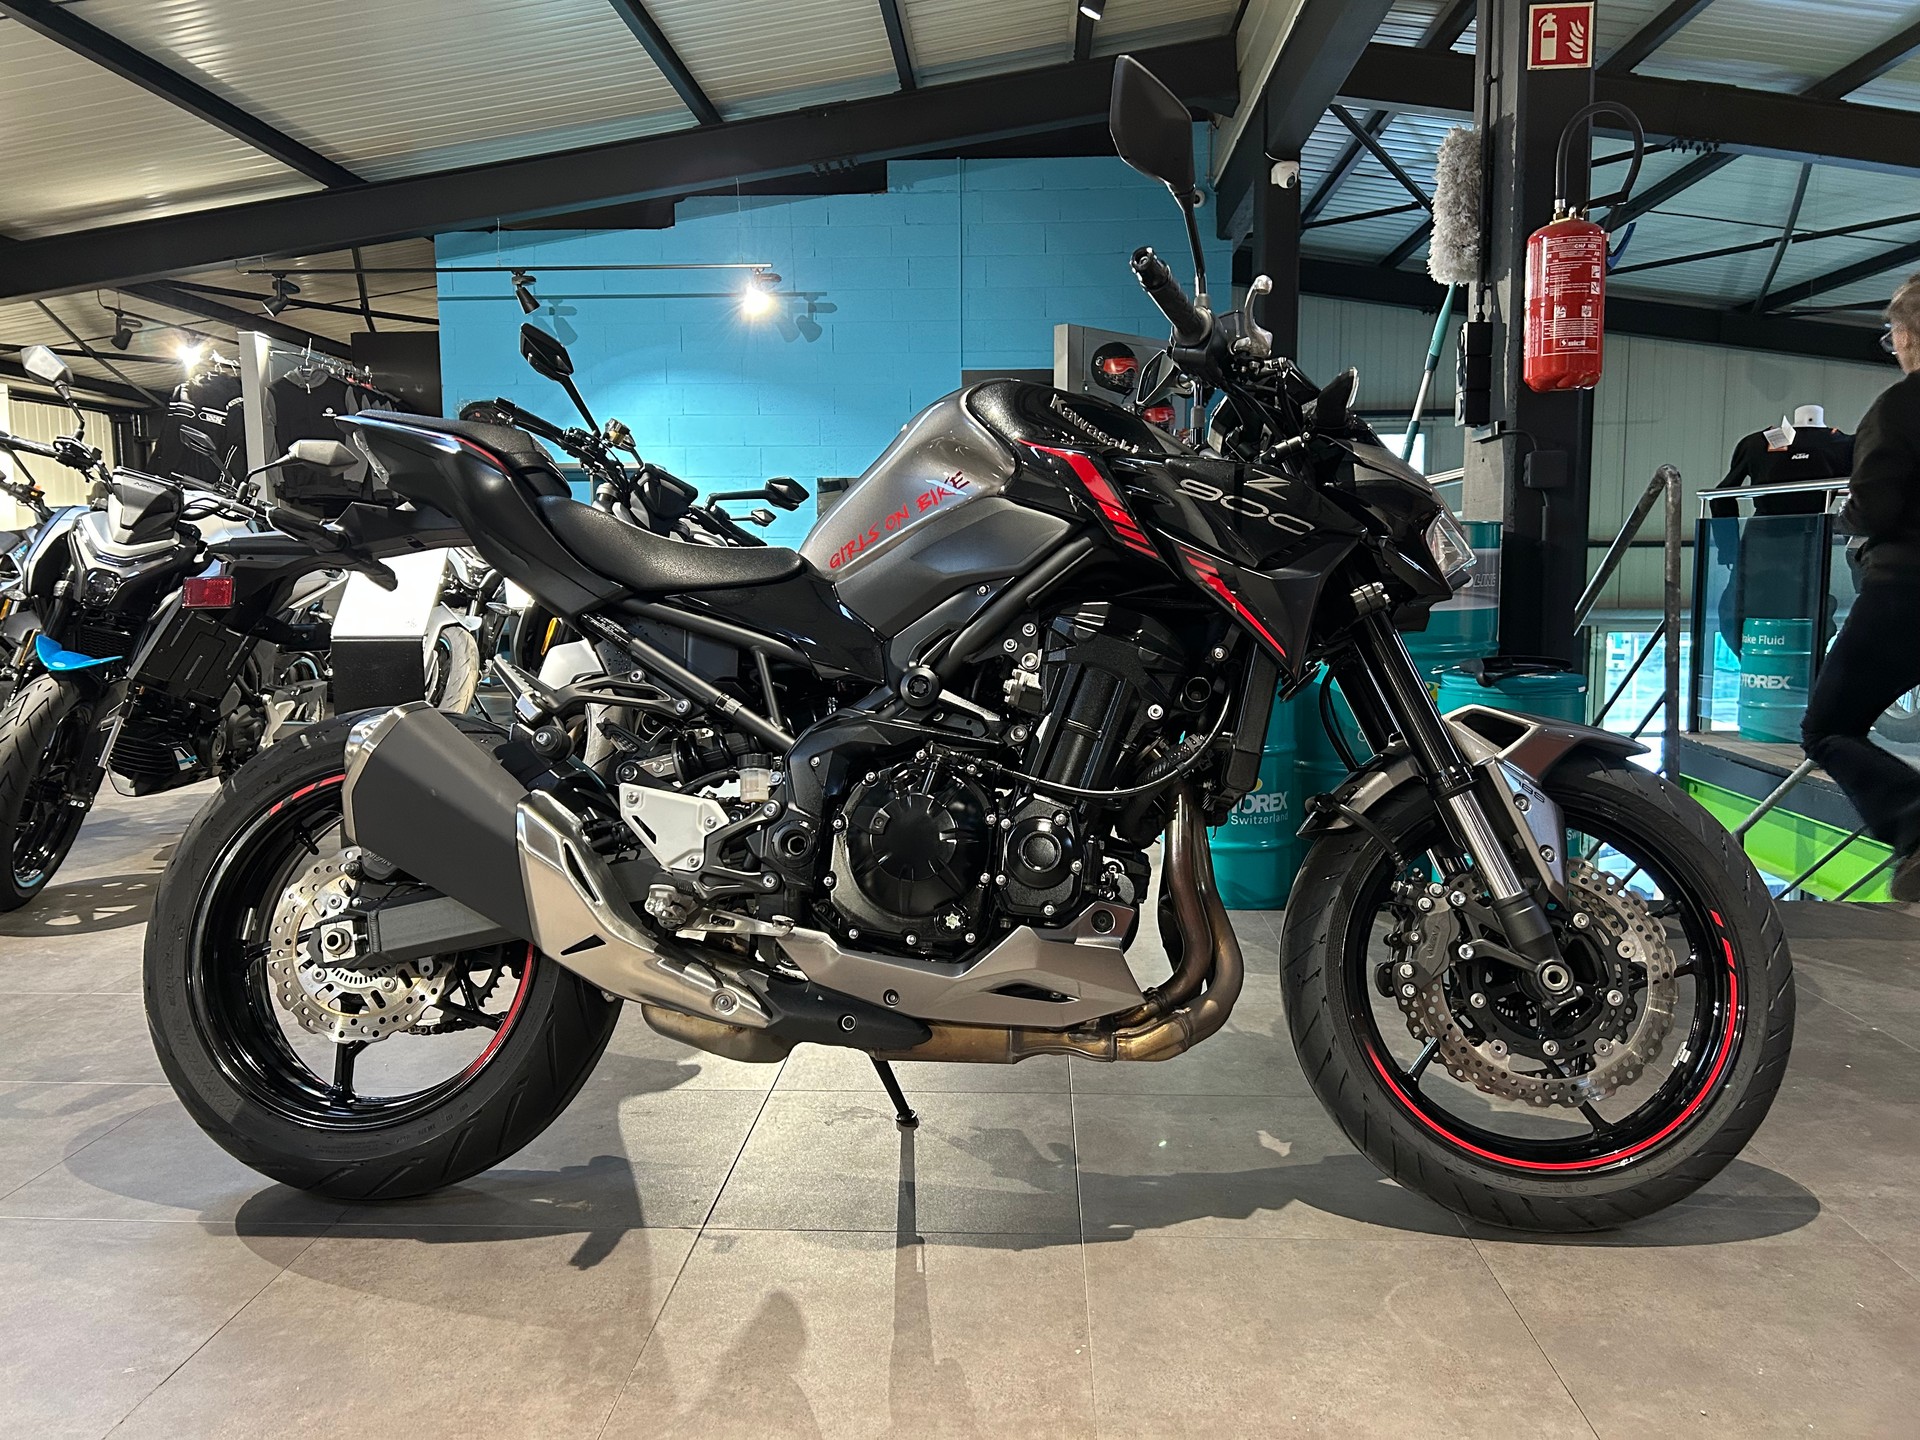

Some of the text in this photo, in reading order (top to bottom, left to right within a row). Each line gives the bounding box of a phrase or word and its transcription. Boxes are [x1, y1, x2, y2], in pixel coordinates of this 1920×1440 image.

[1050, 393, 1139, 454] Kawasaki
[829, 470, 971, 570] GIRLS ON BIKE
[1174, 478, 1316, 536] 900
[1473, 573, 1497, 588] LINE
[1758, 634, 1785, 646] Fluid
[1230, 811, 1289, 825] Switzerland
